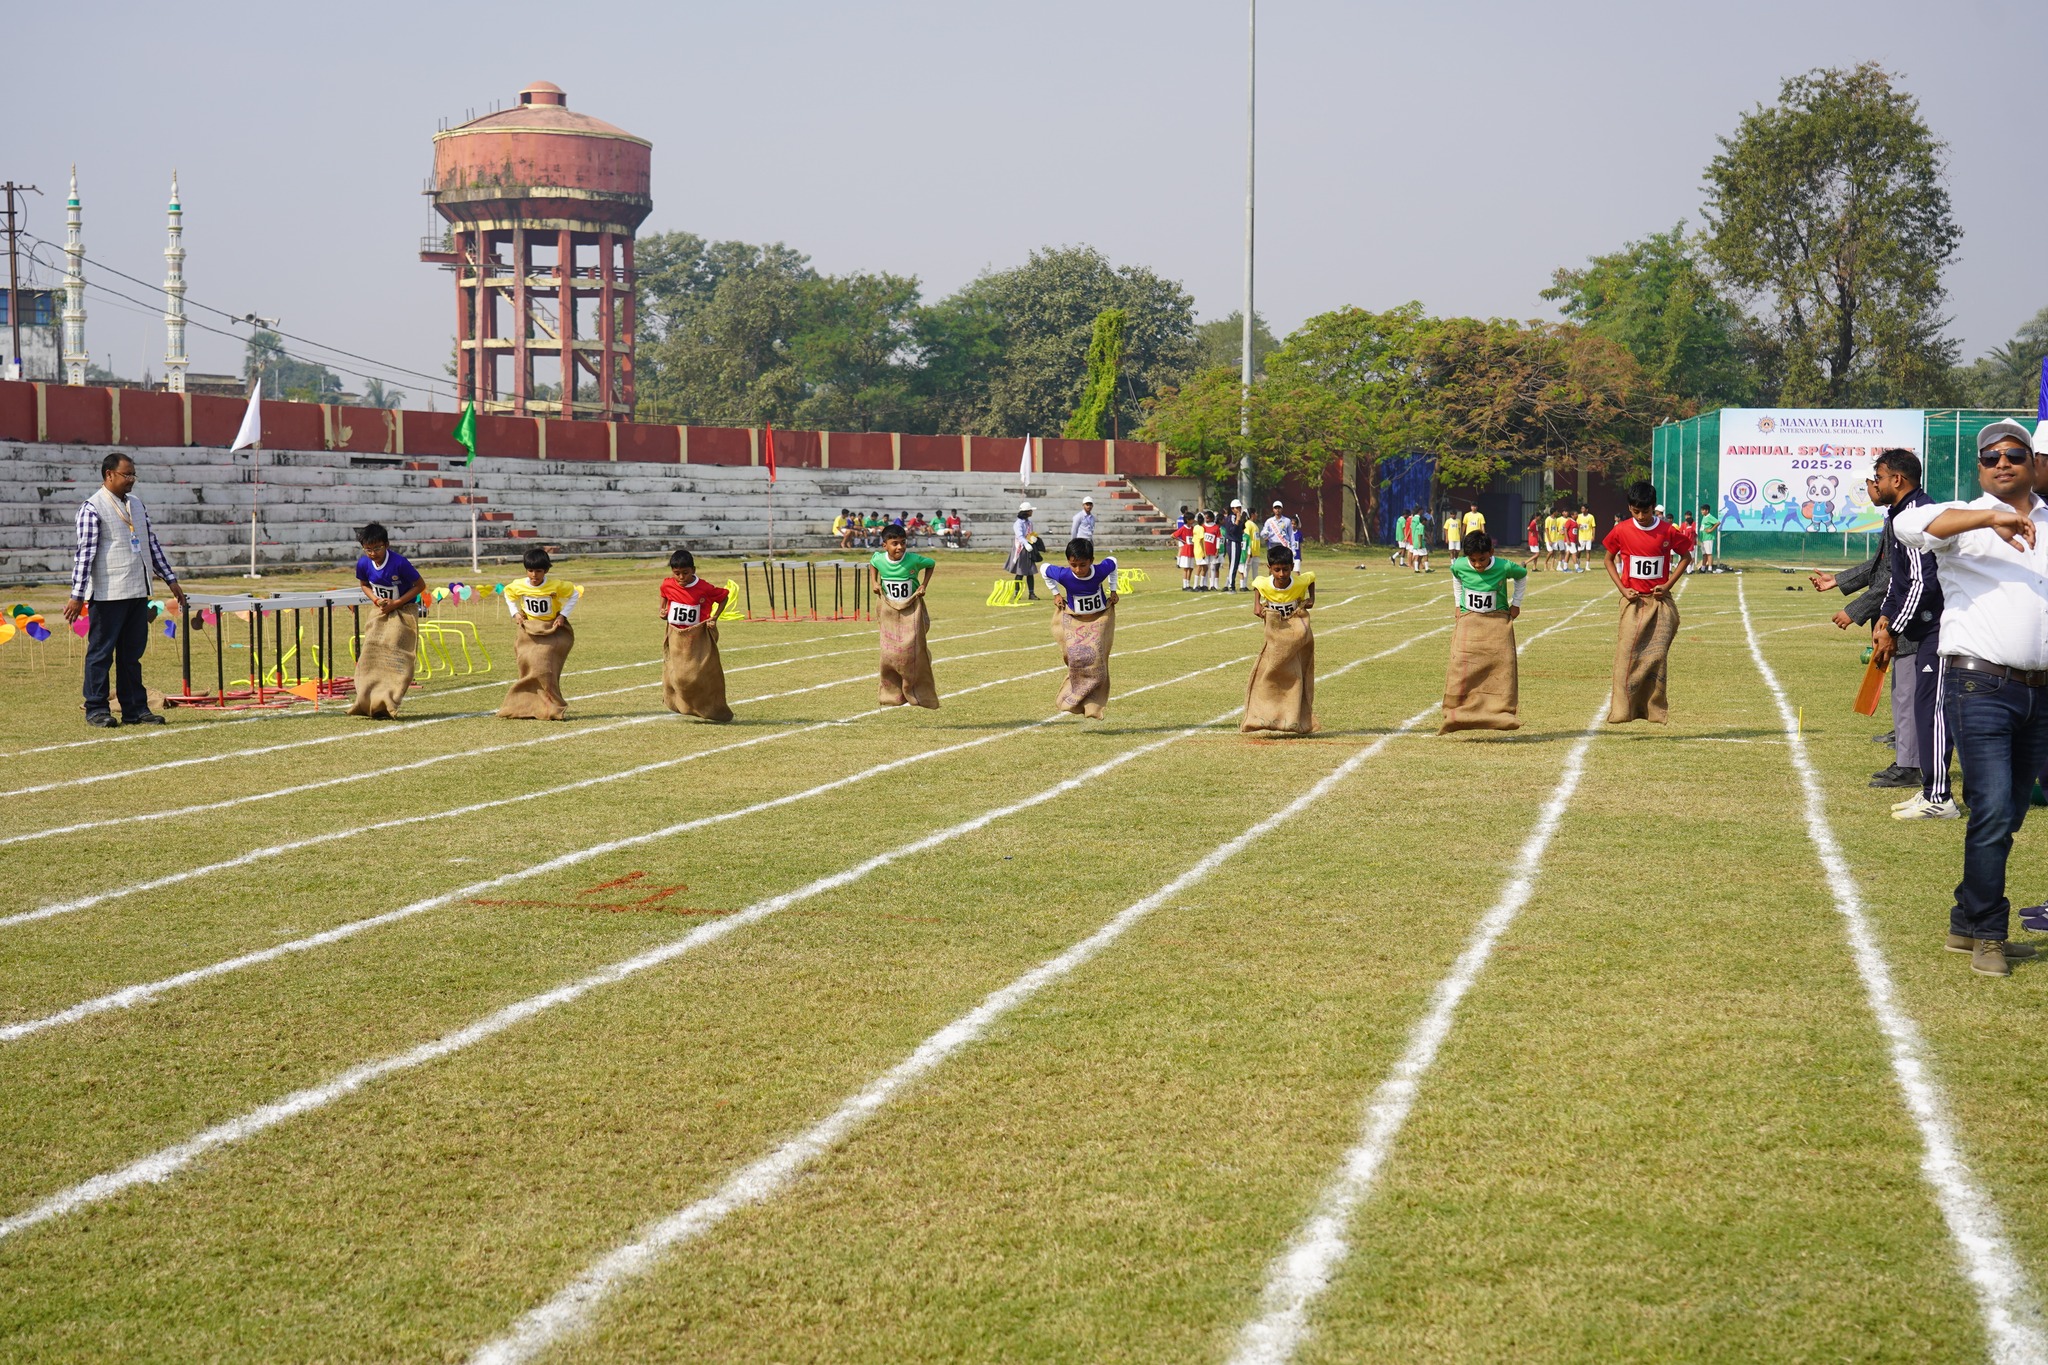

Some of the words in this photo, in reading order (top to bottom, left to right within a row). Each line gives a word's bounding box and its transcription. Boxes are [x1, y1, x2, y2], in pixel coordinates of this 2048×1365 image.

[1780, 418, 1828, 427] MANAVA
[1831, 419, 1883, 428] BHARATI
[1726, 445, 1793, 455] ANNUAL
[1791, 460, 1852, 470] 2025-26
[1635, 560, 1659, 576] 161
[375, 587, 394, 599] 157
[887, 583, 909, 598] 158
[525, 598, 549, 613] 160
[1077, 594, 1102, 612] 156
[1468, 593, 1492, 609] 154
[673, 607, 697, 622] 159
